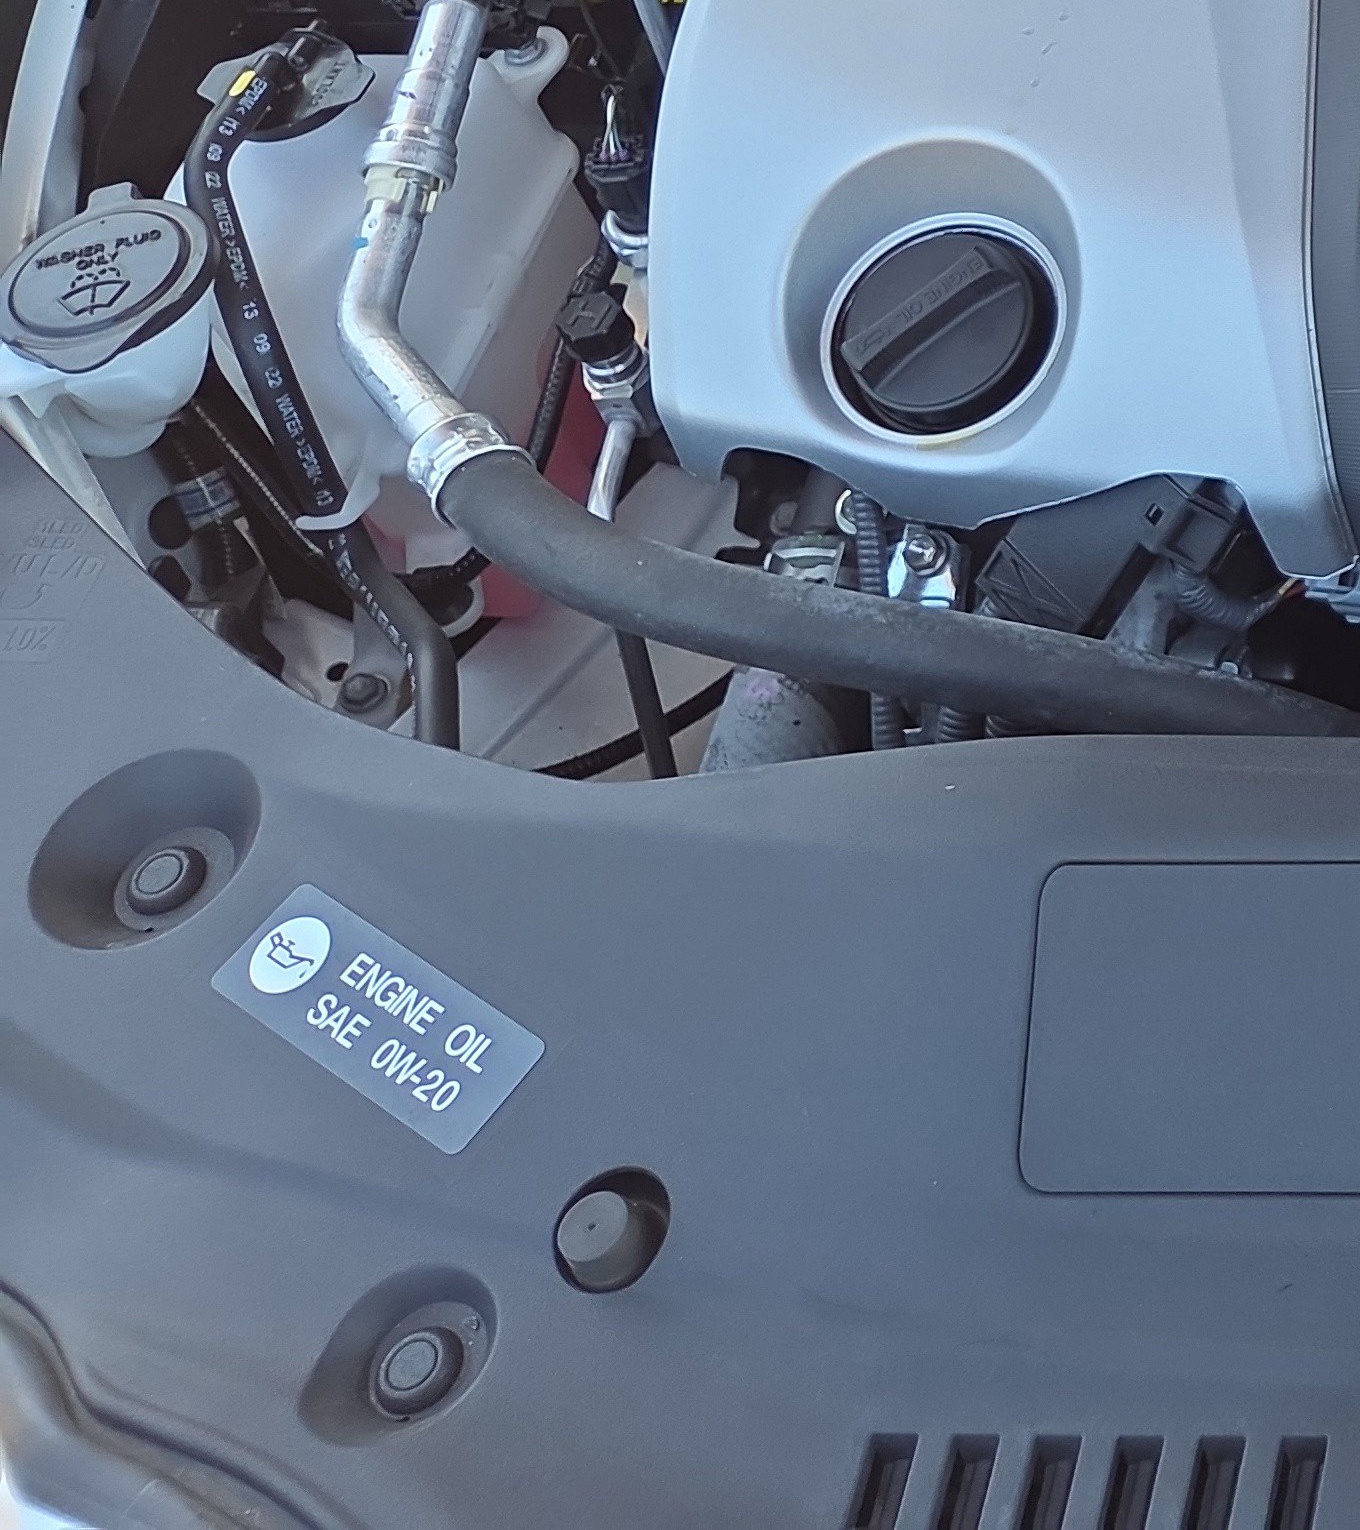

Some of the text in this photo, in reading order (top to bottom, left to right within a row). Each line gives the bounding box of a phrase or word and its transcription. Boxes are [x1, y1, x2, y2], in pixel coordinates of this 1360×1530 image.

[35, 229, 162, 270] WASHER FLUID
[75, 251, 119, 271] ONLY
[254, 333, 271, 353] 09
[276, 393, 304, 438] WATER
[306, 993, 460, 1113] SAE 0W-20
[339, 951, 496, 1074] ENGINE OIL
